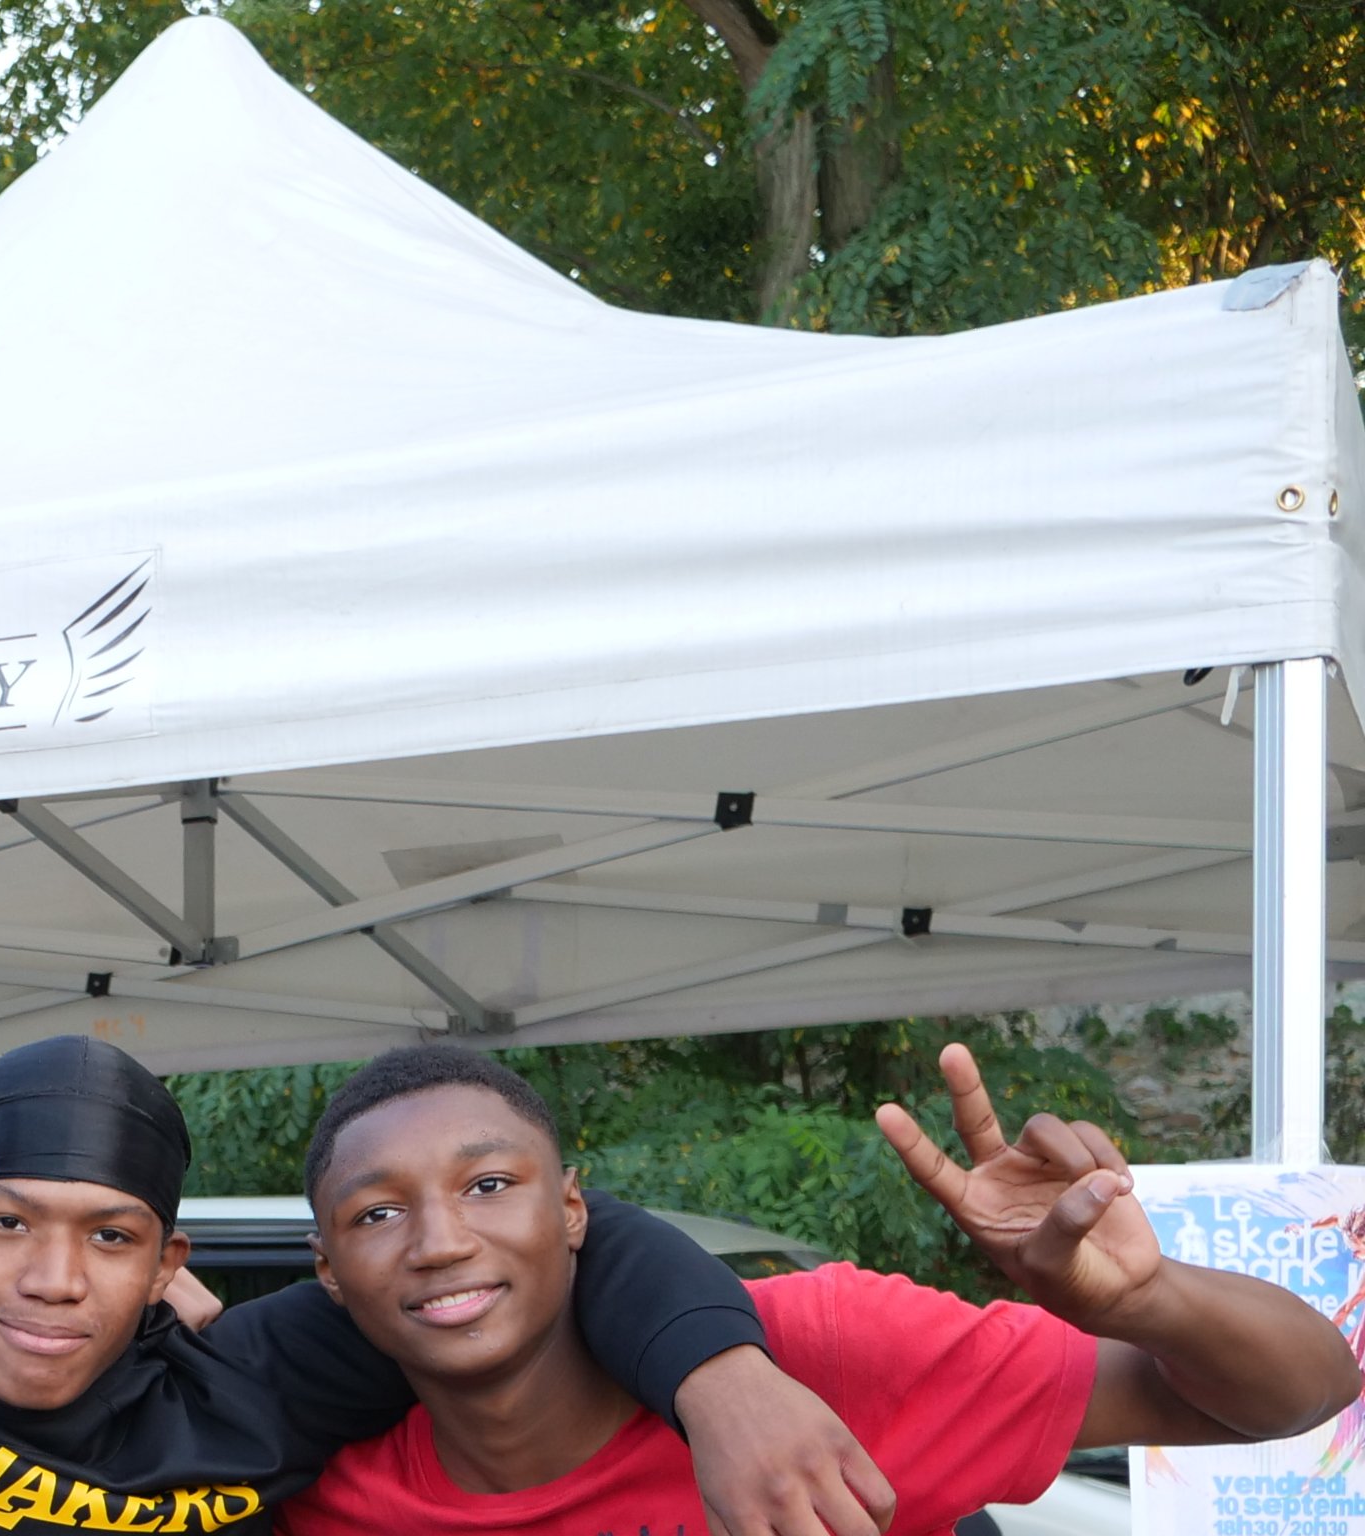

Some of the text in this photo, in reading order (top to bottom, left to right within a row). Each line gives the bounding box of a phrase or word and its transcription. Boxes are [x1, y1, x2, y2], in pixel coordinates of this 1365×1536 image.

[1213, 1194, 1253, 1221] Le
[1213, 1217, 1339, 1259] skate
[1213, 1470, 1347, 1495] vendredi
[1213, 1497, 1239, 1515] 10
